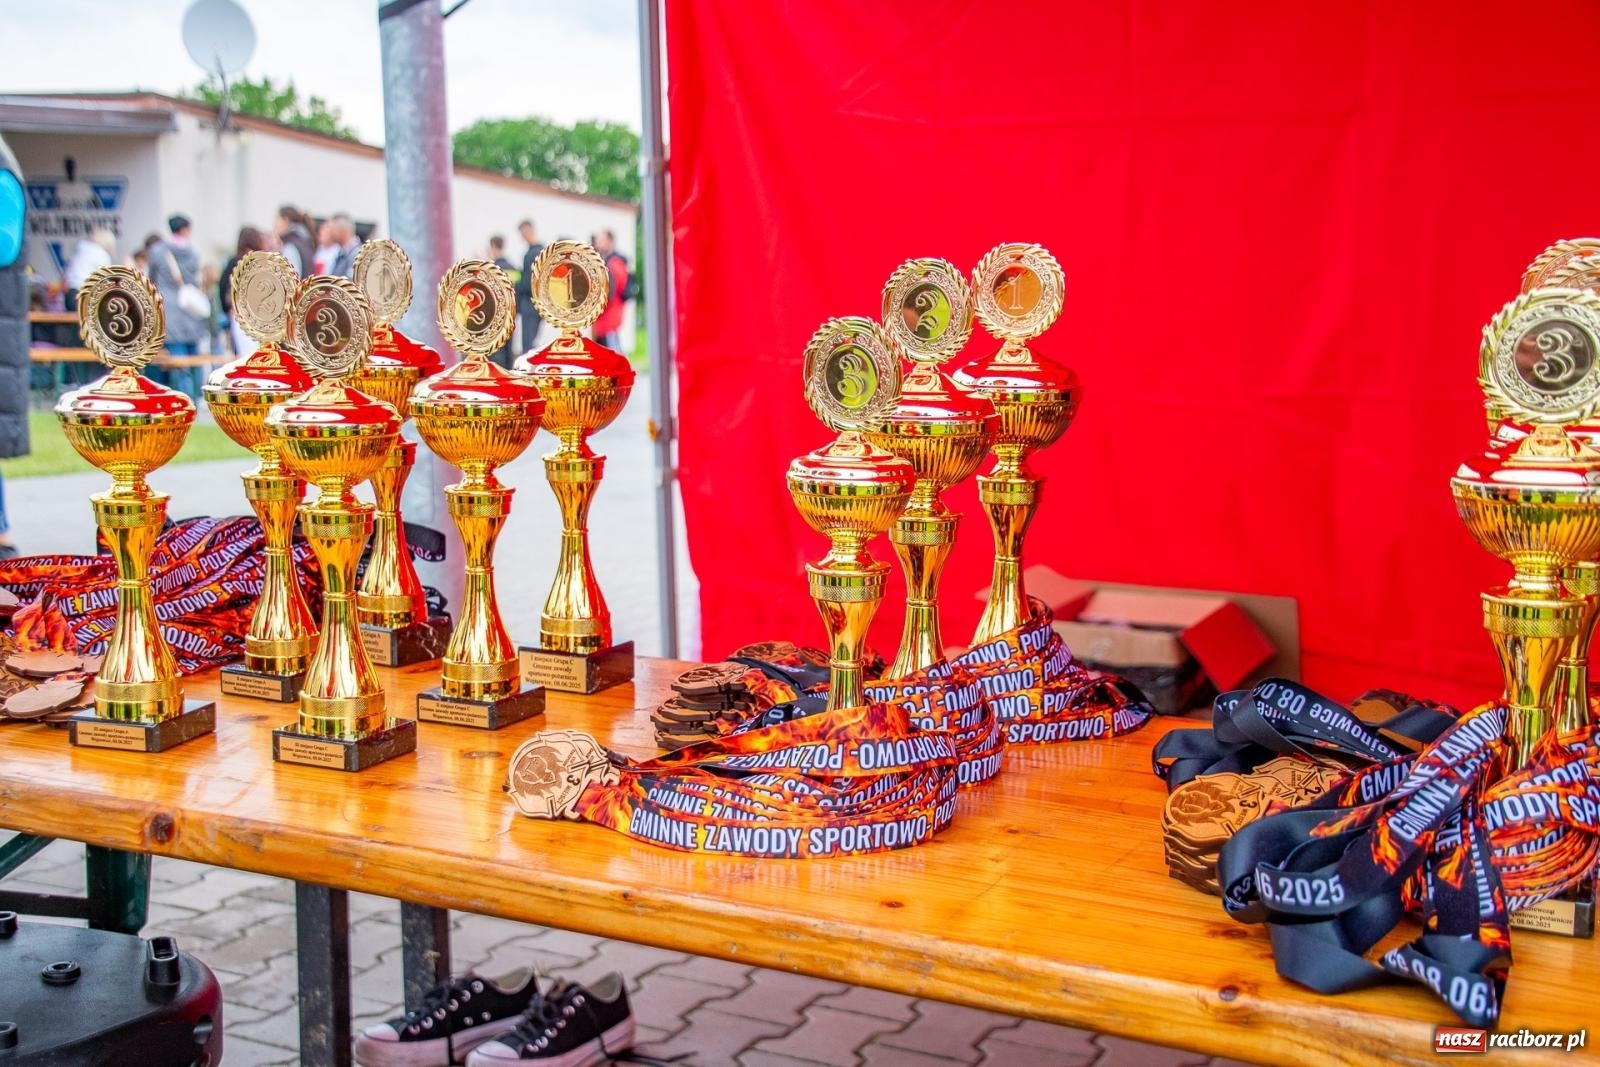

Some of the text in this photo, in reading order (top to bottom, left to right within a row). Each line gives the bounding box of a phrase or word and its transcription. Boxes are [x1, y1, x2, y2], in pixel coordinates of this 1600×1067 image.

[107, 297, 134, 338] 3
[314, 306, 342, 348] 3
[1532, 328, 1577, 384] 3
[1008, 715, 1110, 743] SPORTOWO-
[629, 806, 698, 849] GMINNE
[703, 823, 802, 856] ZAWODY
[809, 815, 931, 855] SPORTOWO-
